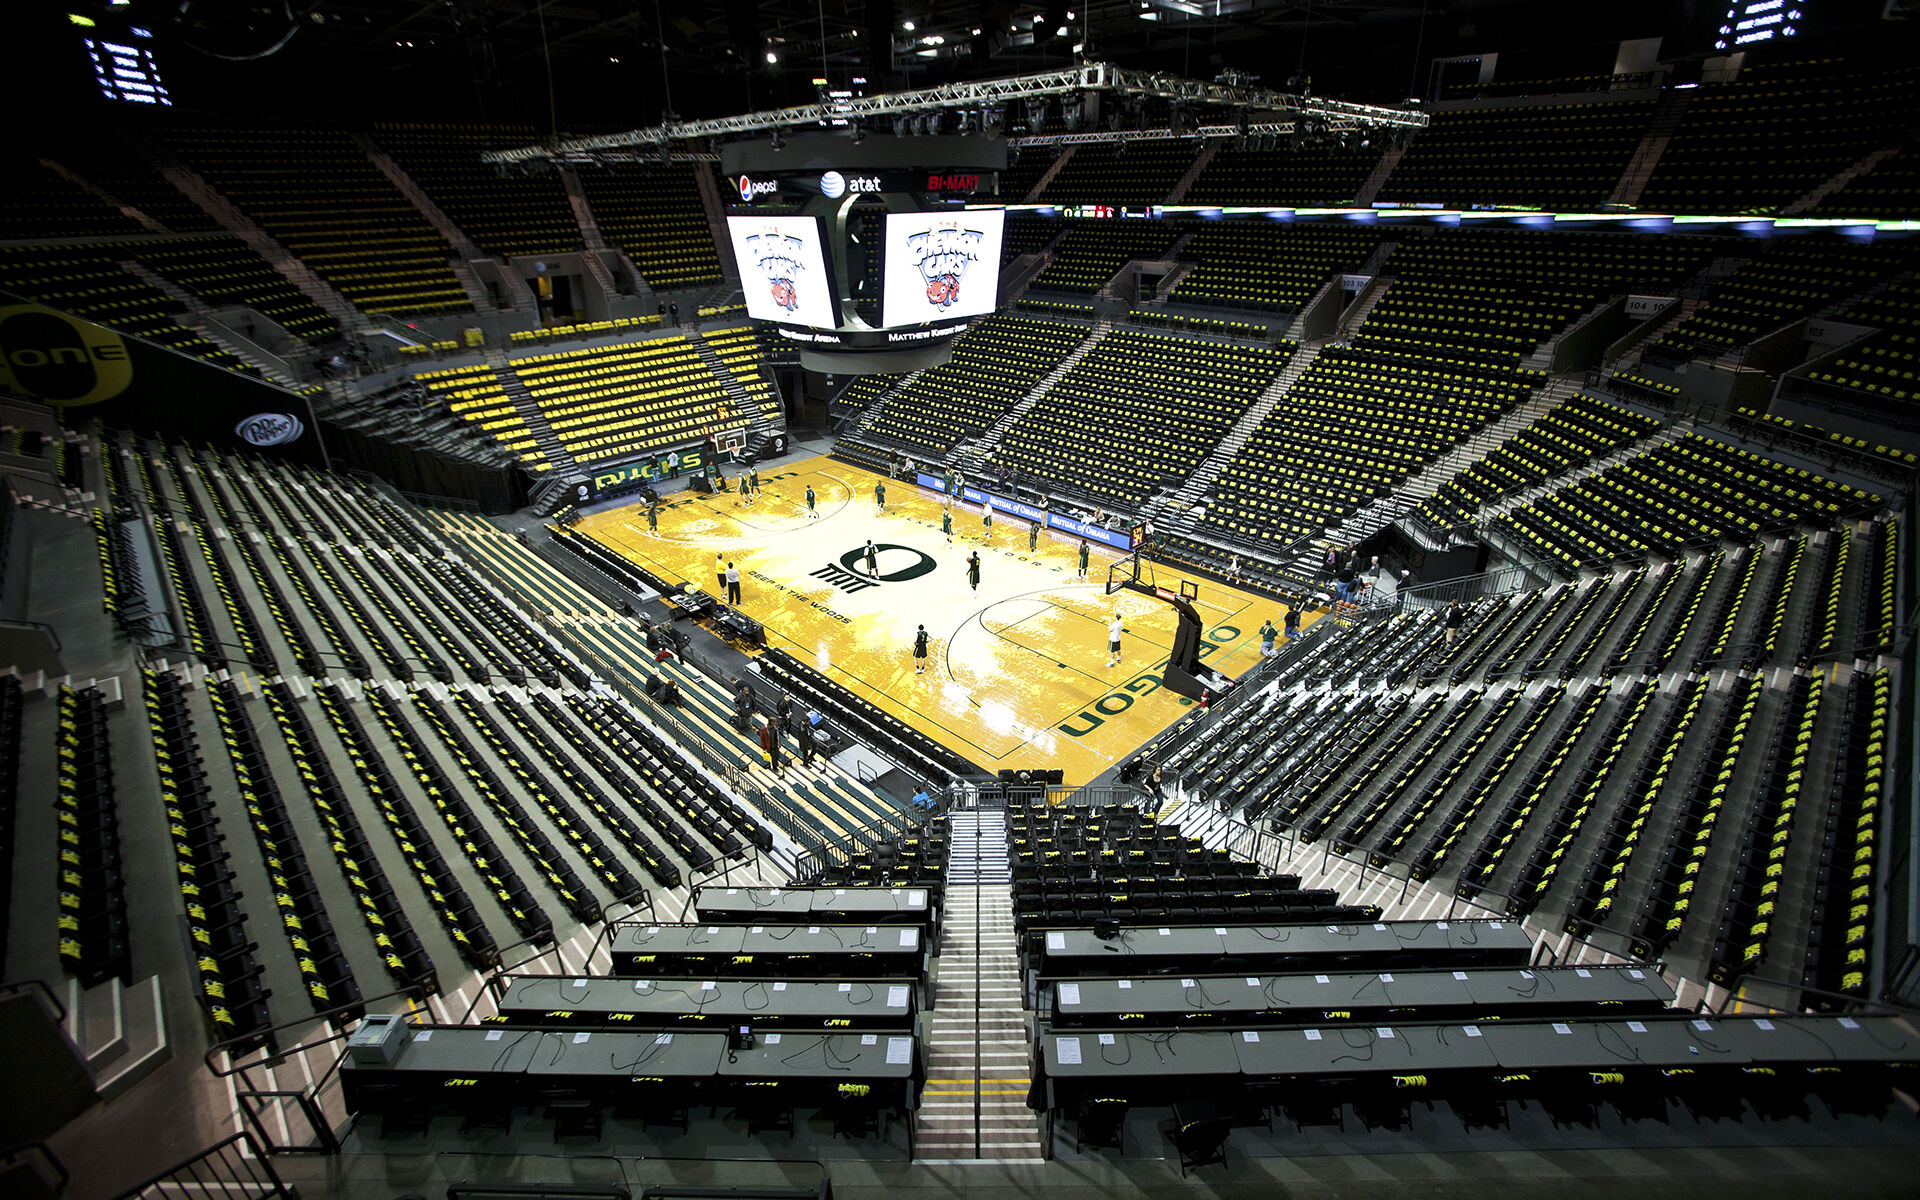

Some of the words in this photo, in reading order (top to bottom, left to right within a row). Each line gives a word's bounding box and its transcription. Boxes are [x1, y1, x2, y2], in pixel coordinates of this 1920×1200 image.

[850, 176, 881, 192] at&t
[1631, 302, 1647, 310] 104
[889, 332, 930, 342] MATTHEW
[1809, 327, 1824, 337] 105
[249, 421, 290, 443] Pepper
[990, 496, 1012, 511] MUTUAL
[1051, 515, 1076, 528] MUTUAL
[1077, 523, 1086, 534] of
[1086, 526, 1110, 541] OMAHA
[788, 590, 809, 602] THE
[810, 601, 852, 624] WOODS
